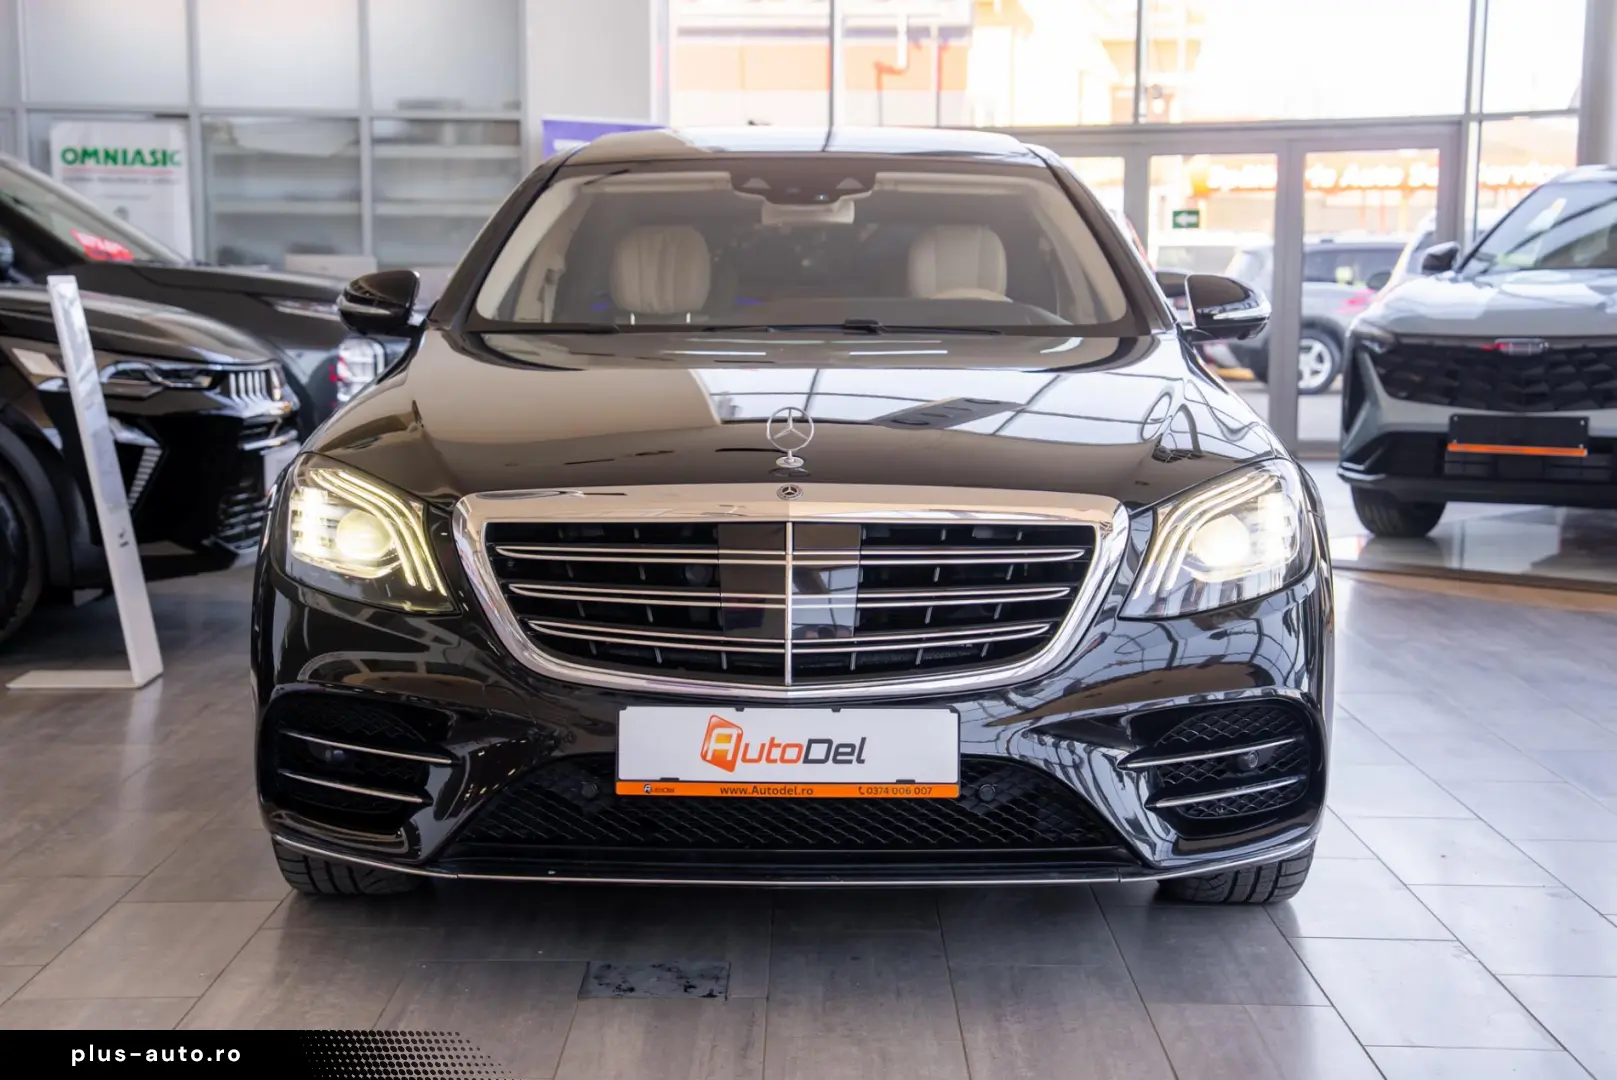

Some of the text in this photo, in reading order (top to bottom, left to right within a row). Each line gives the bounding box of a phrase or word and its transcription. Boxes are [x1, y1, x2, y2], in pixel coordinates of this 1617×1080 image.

[702, 721, 867, 767] AutoDel
[719, 785, 814, 797] www.Autodel.ro
[866, 786, 889, 796] 0374
[914, 786, 933, 796] 007
